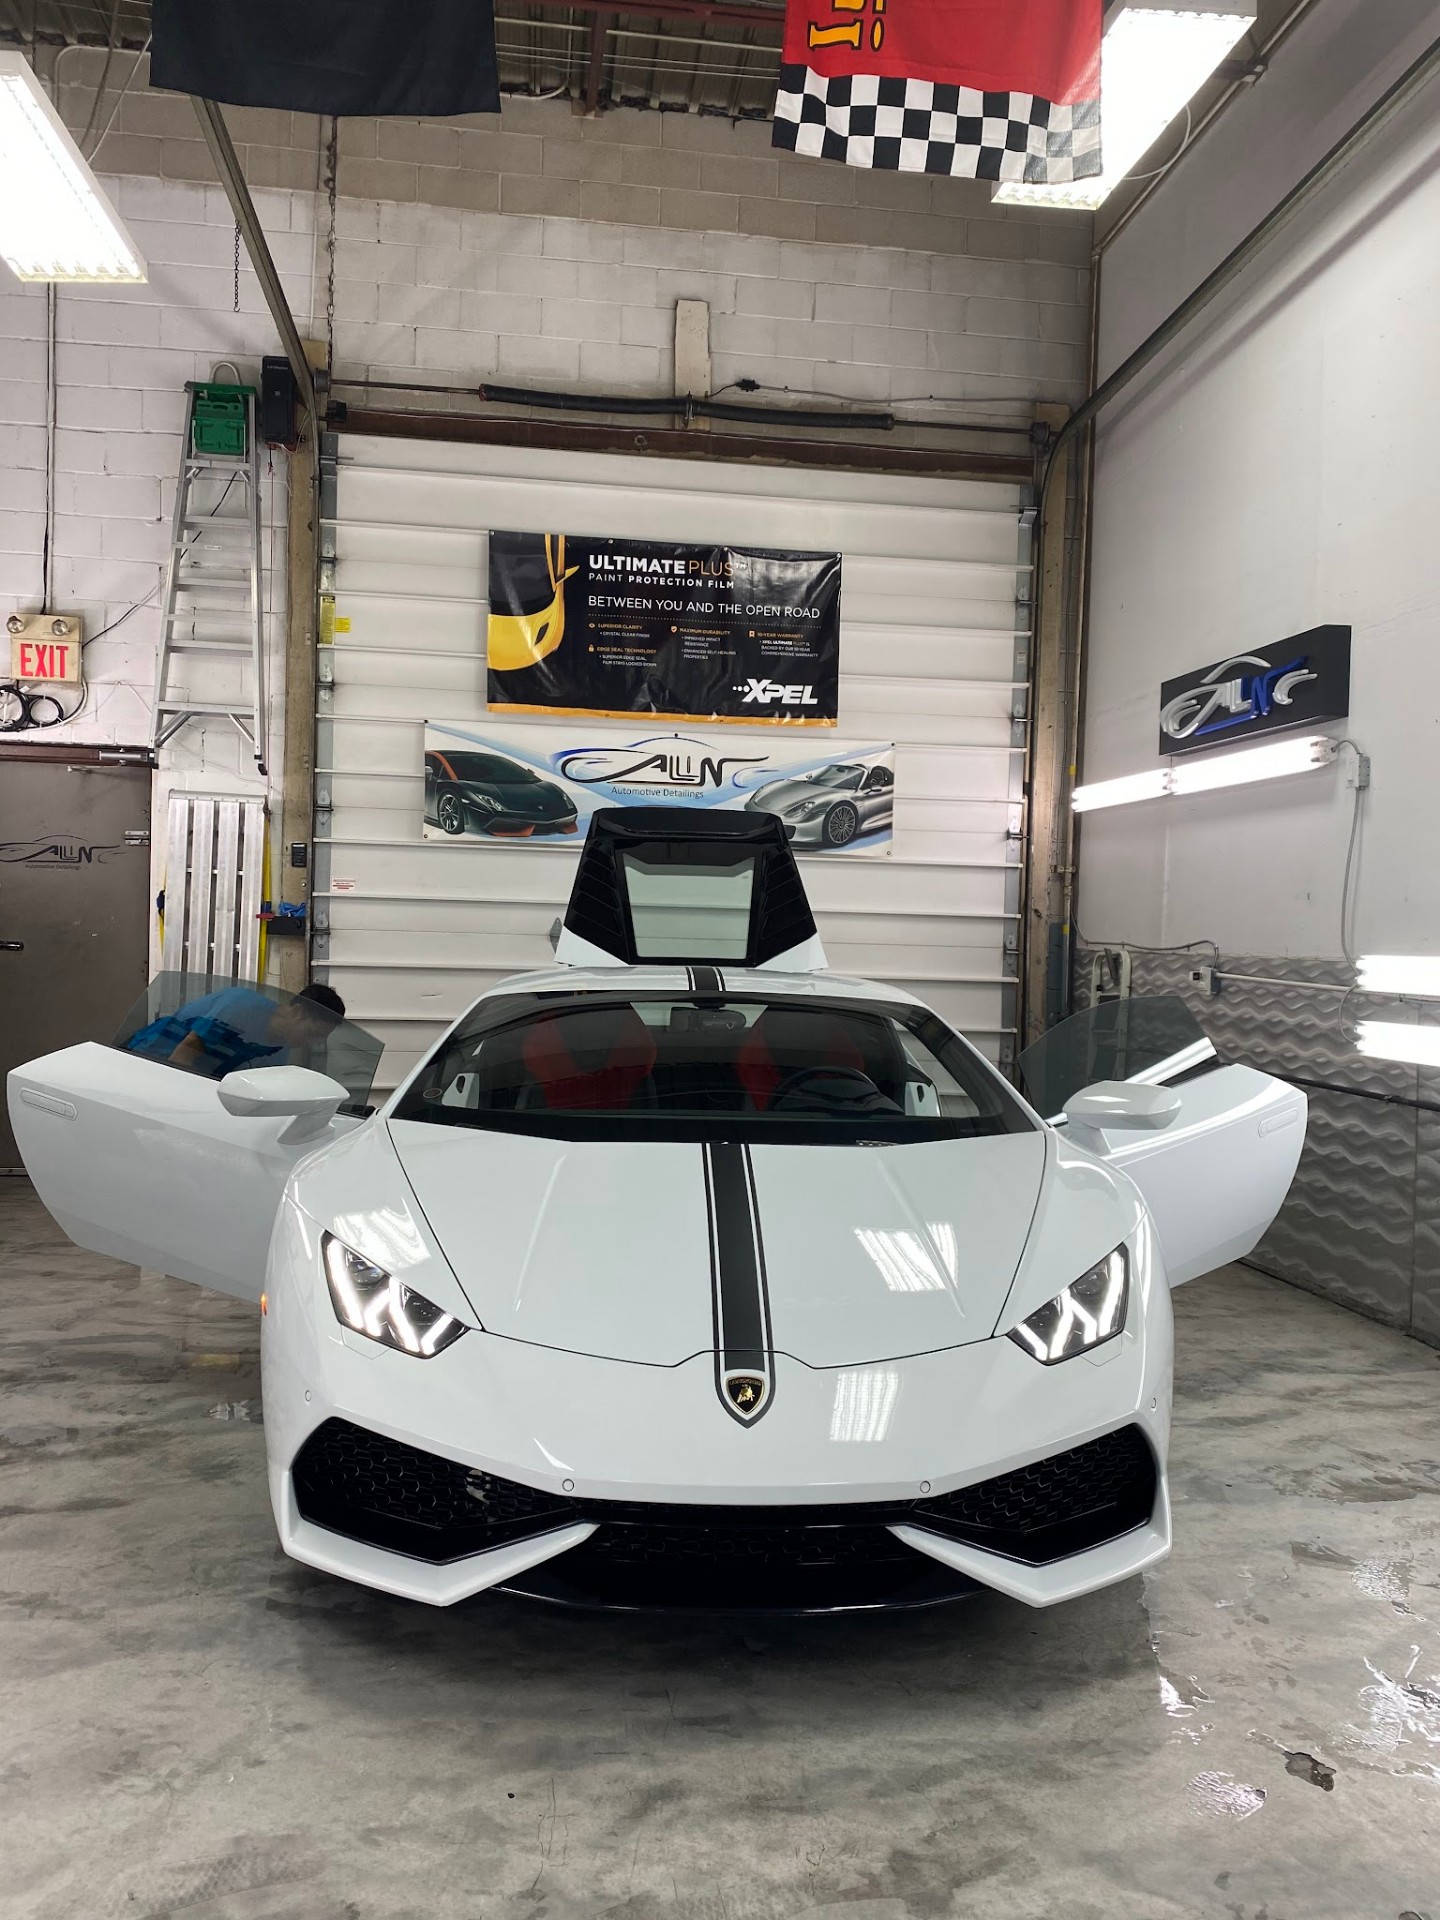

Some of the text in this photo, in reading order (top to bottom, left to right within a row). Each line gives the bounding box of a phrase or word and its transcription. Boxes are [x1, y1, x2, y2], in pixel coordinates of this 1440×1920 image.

[589, 555, 686, 575] ULTIMATE
[588, 572, 735, 589] PAINT PROTECTION FILM
[588, 595, 820, 618] BETWEEN YOU AND THE OPEN ROAD
[20, 643, 69, 678] EXIT
[742, 678, 818, 705] XPEL
[611, 786, 704, 799] Automotive Detailings
